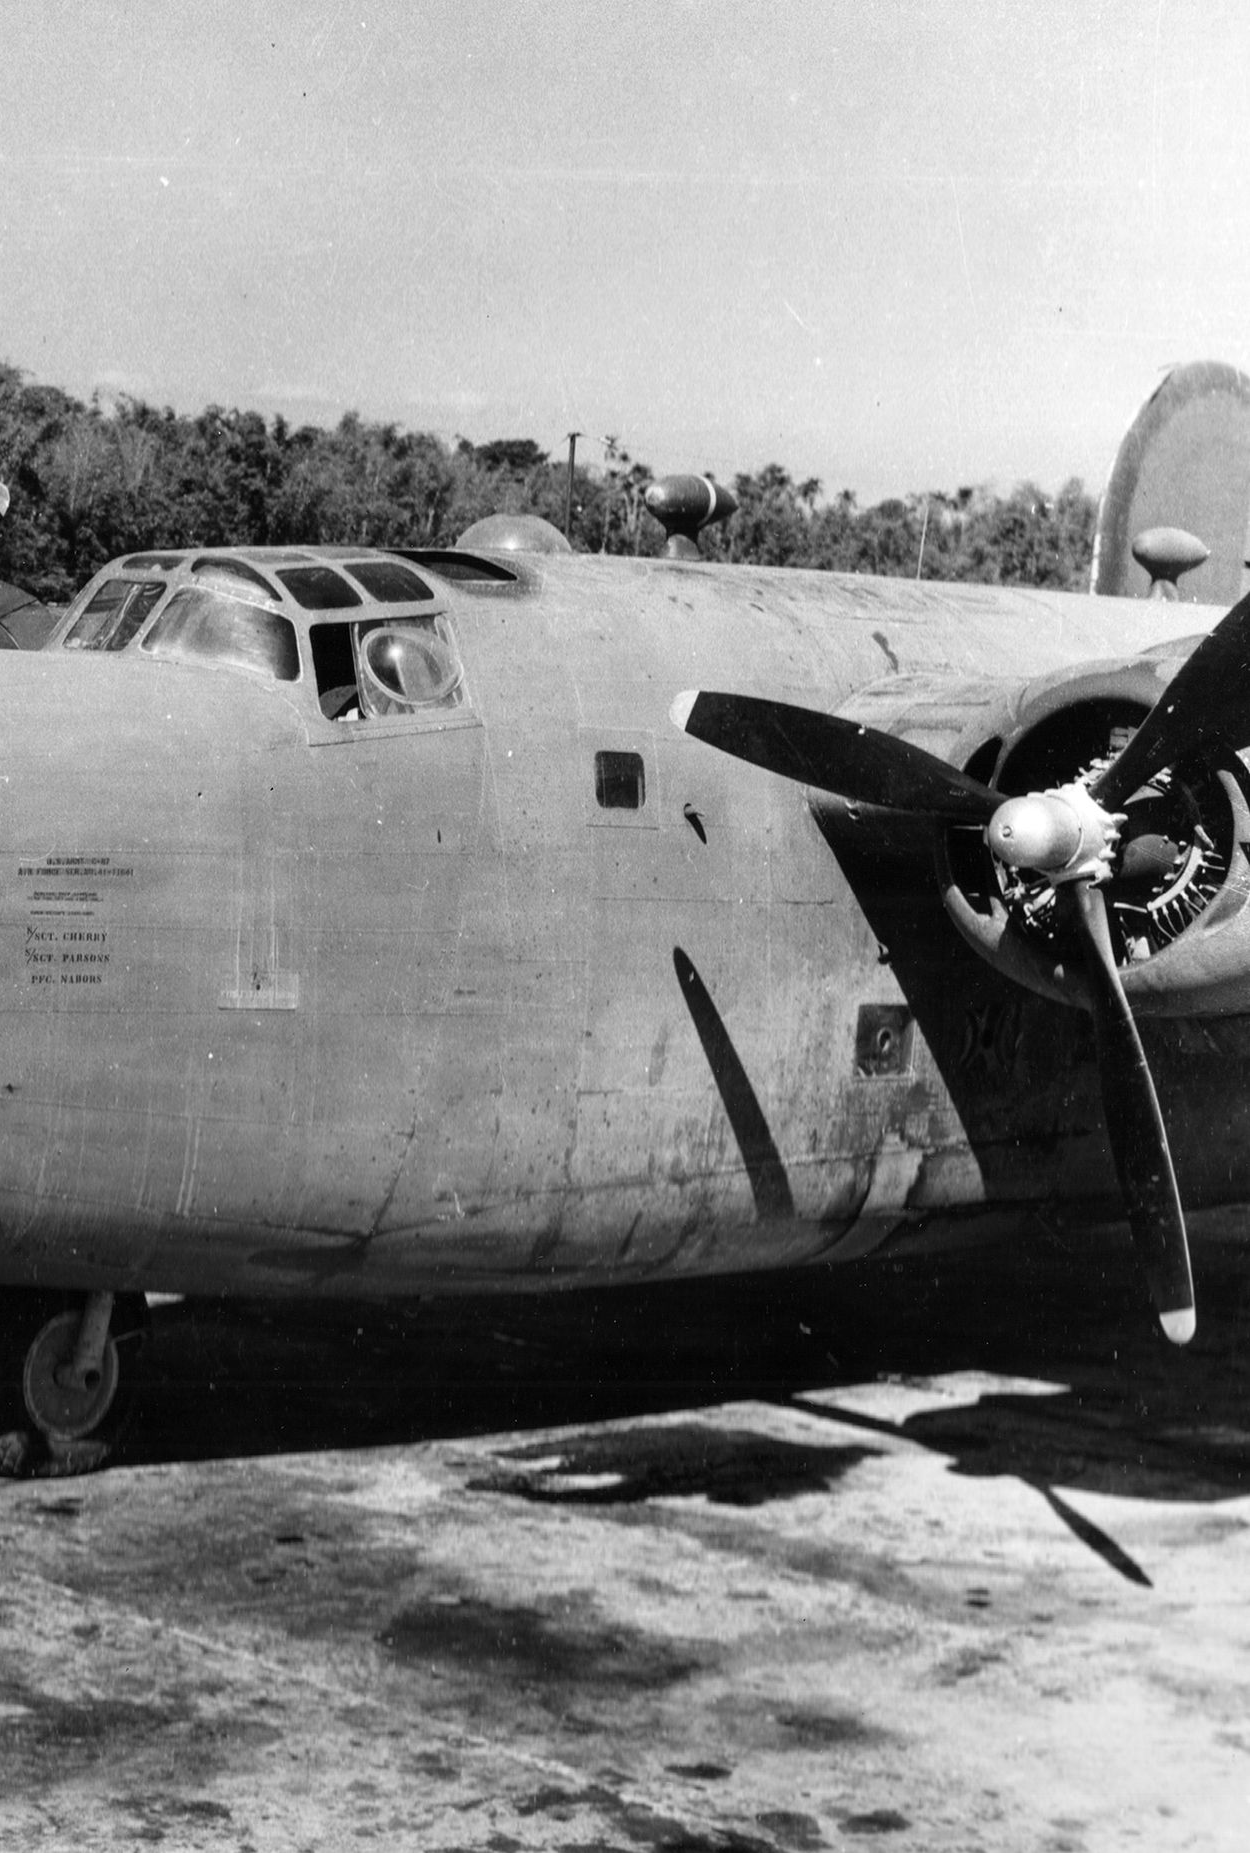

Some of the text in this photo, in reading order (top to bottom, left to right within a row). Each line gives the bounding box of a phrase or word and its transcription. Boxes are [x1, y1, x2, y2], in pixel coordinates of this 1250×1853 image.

[17, 867, 33, 876] AIR
[36, 867, 59, 876] FORCE
[62, 931, 108, 942] CHERRY
[62, 953, 110, 963] PARSONS
[61, 974, 103, 984] NABORS
